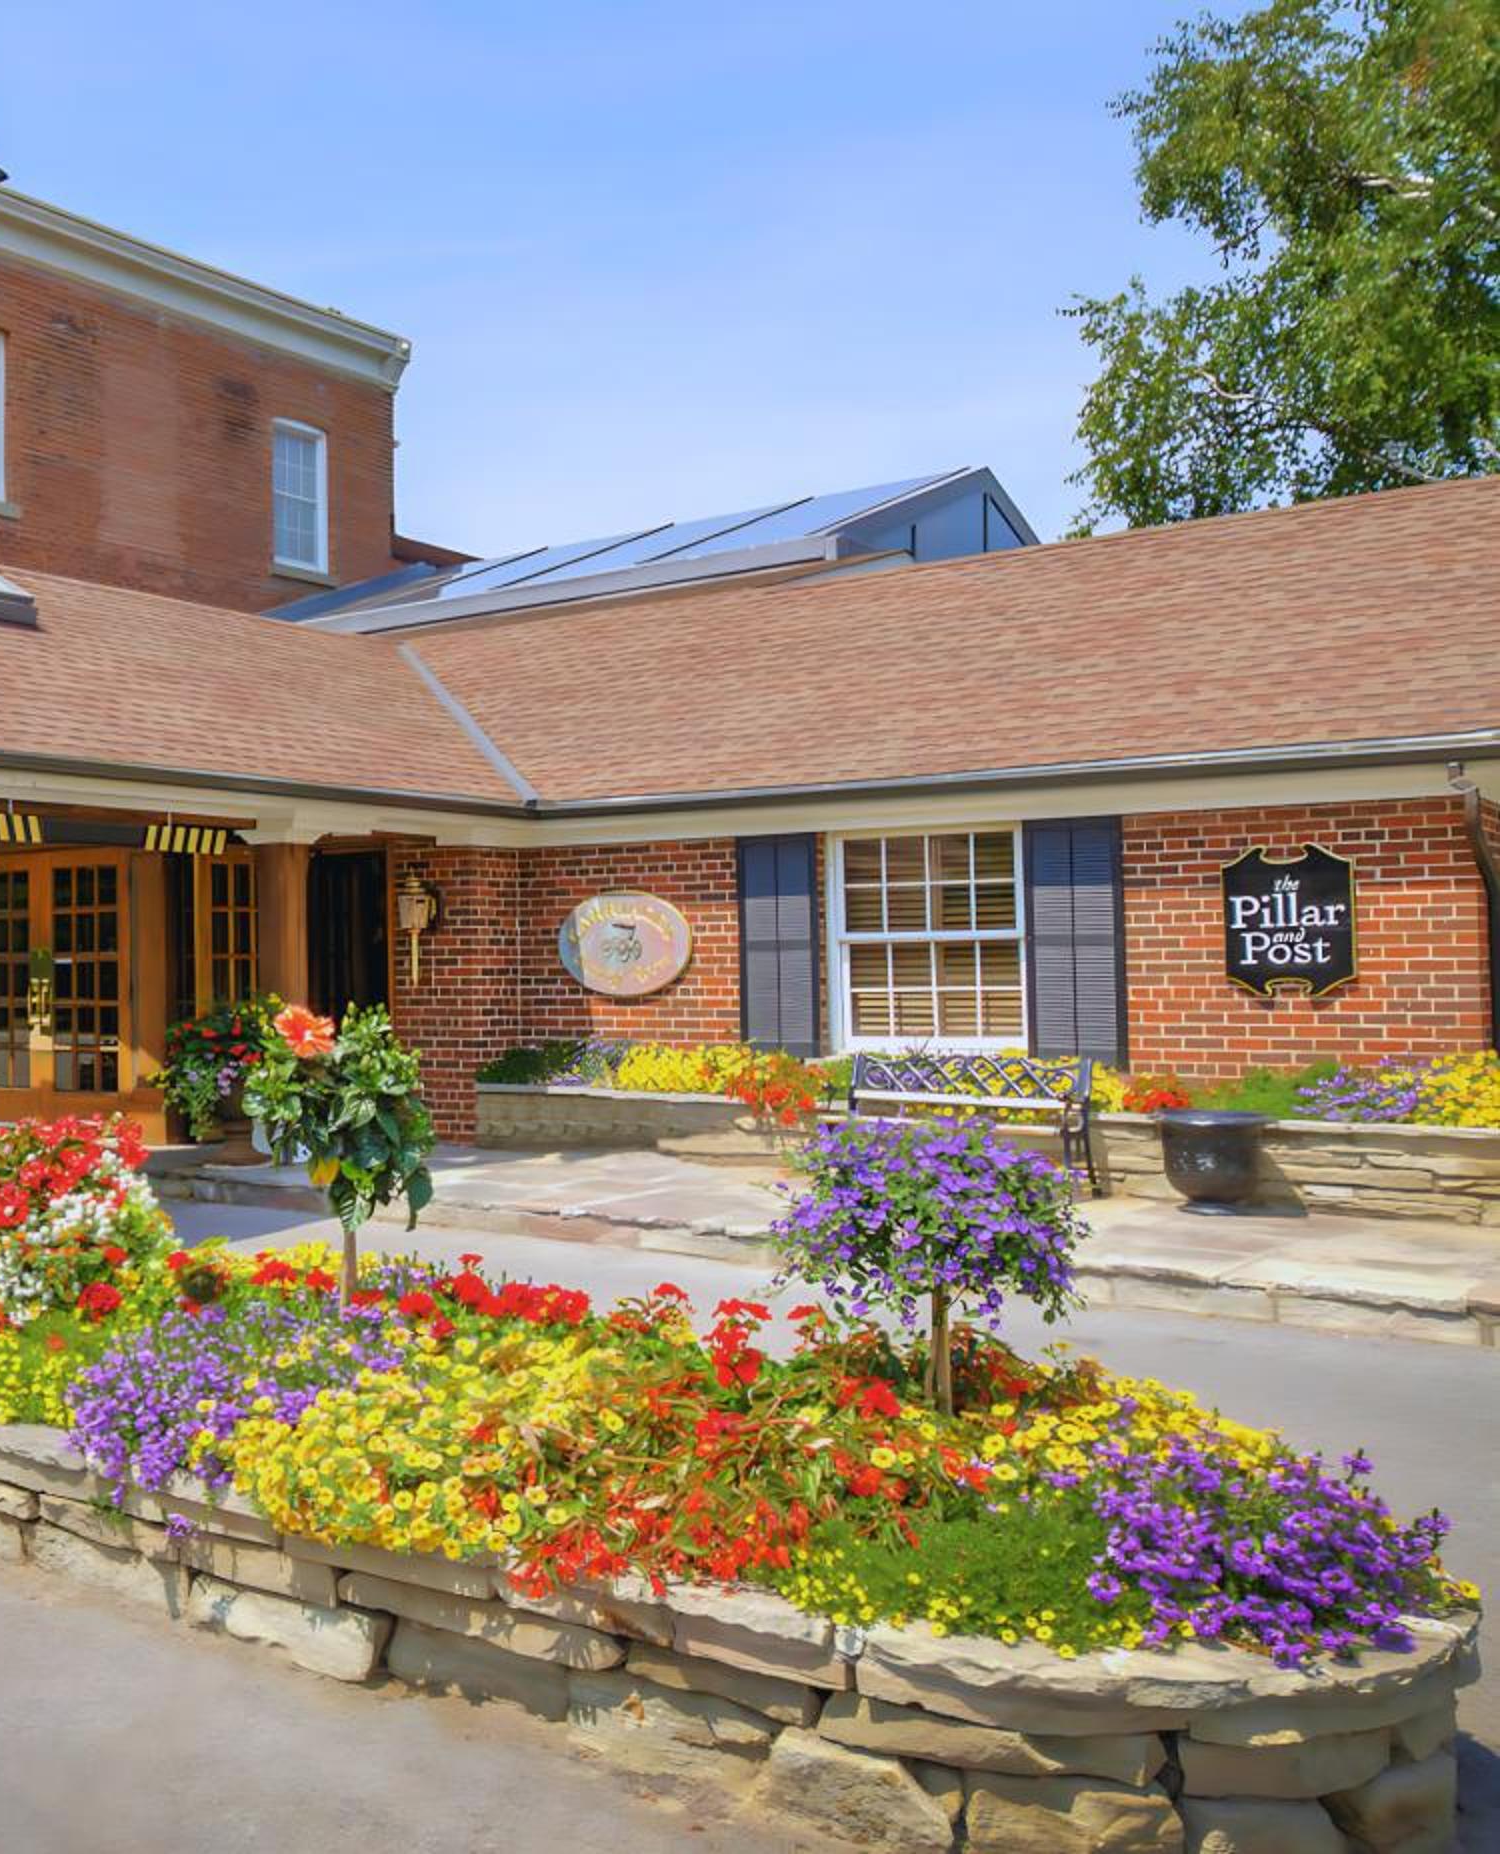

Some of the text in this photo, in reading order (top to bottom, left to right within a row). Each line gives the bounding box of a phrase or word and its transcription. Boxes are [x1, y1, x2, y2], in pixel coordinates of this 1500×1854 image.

[1272, 872, 1301, 892] the
[1228, 891, 1345, 929] Pillar
[1239, 932, 1332, 965] Post
[1272, 928, 1306, 943] and
